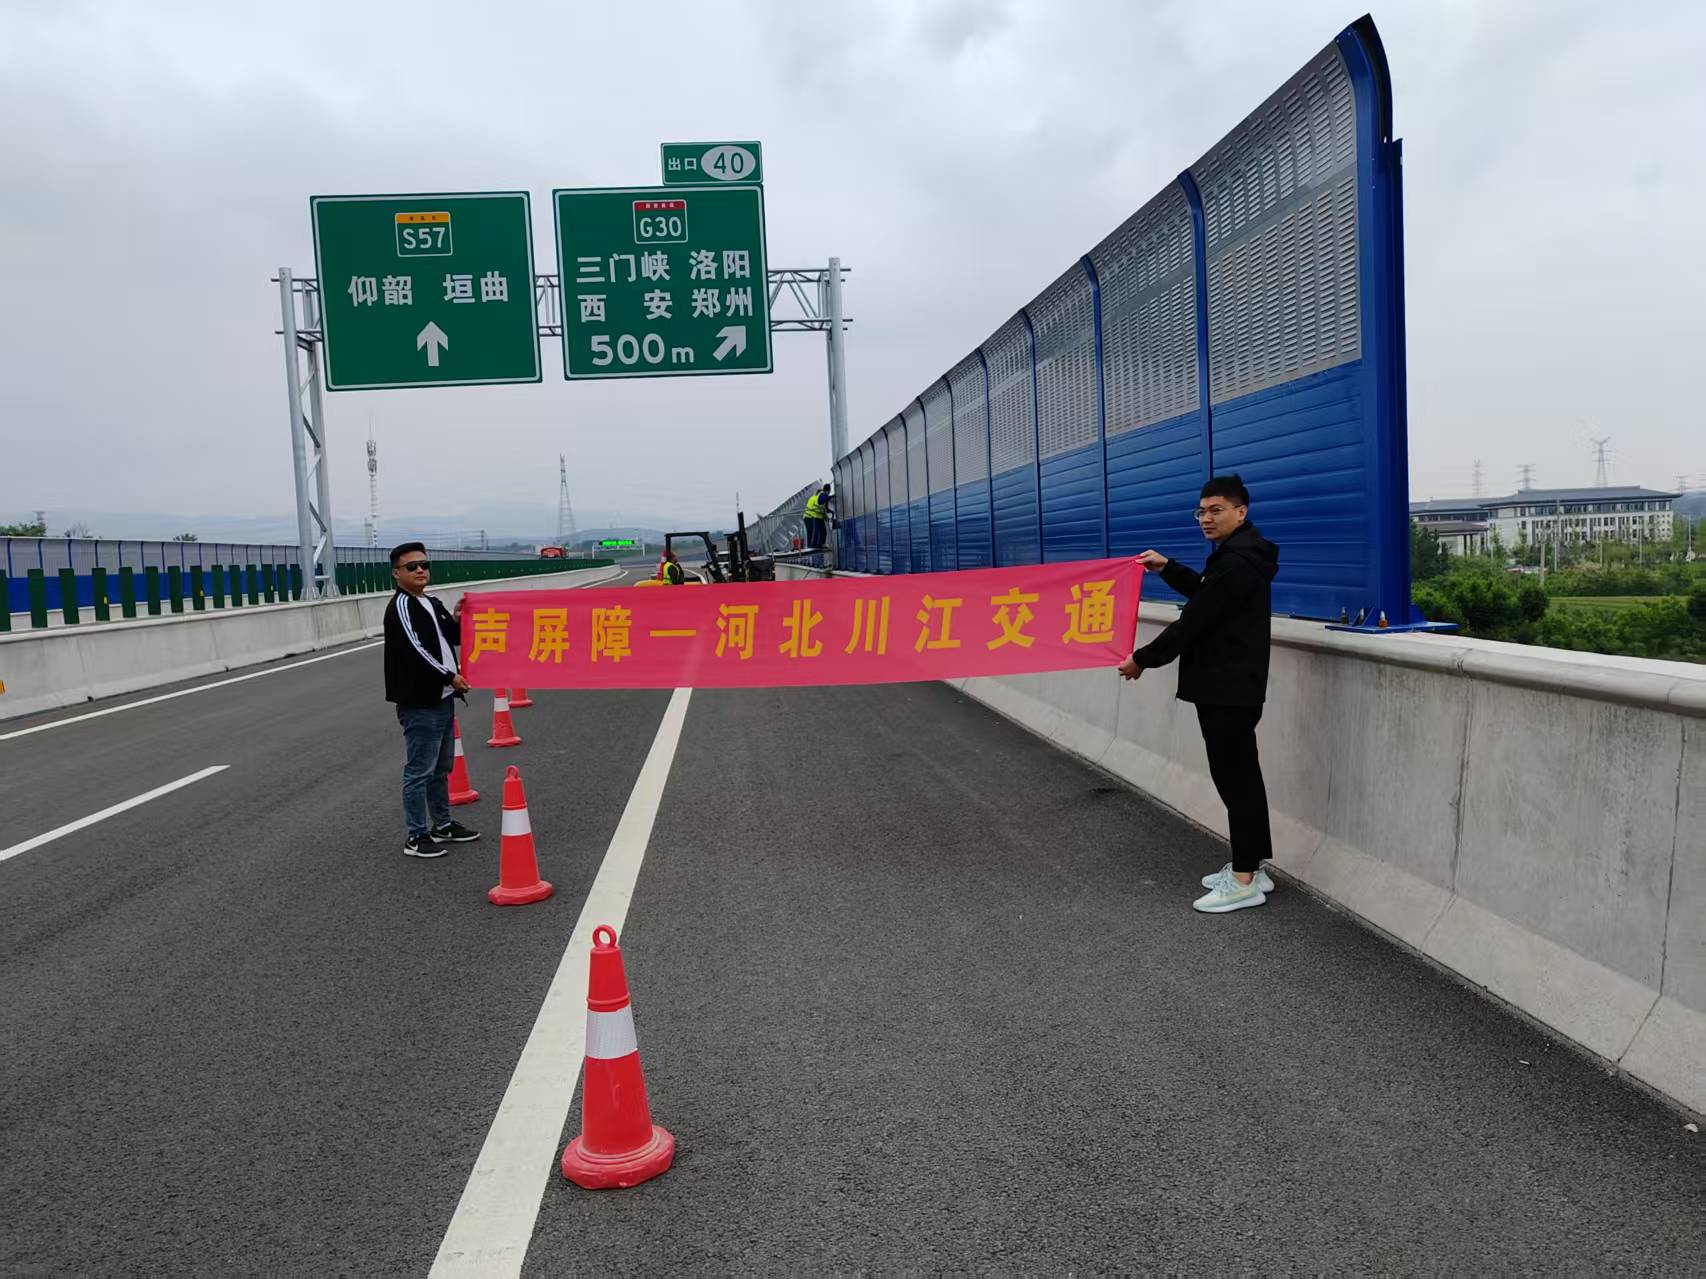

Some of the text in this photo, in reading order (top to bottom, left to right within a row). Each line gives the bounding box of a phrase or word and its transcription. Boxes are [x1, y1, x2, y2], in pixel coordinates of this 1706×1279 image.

[667, 151, 744, 174] 出口 40
[402, 227, 446, 249] S57
[640, 216, 682, 237] G30
[576, 249, 751, 283] 三门峡 洛阳
[347, 270, 509, 307] 仰韶 垣曲
[691, 286, 753, 319] 郑州
